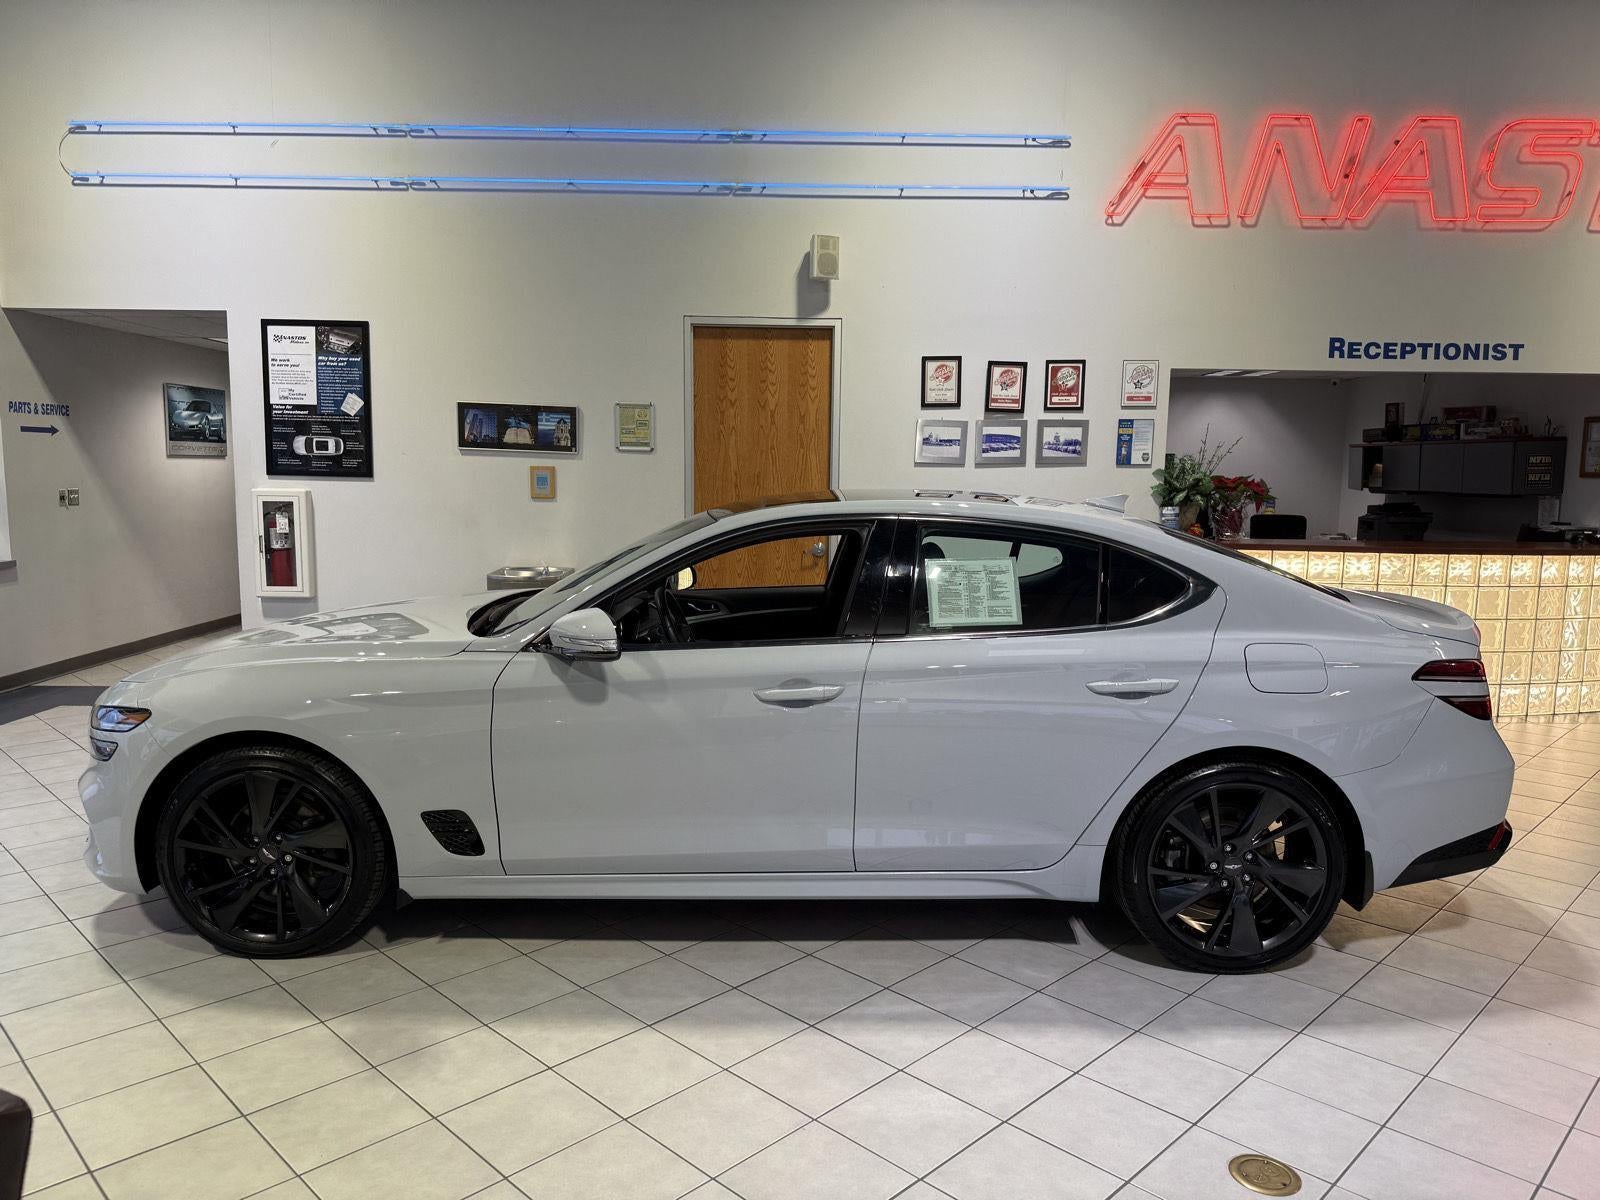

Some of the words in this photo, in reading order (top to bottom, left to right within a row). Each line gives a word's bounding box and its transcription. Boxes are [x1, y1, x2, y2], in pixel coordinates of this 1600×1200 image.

[1105, 112, 1600, 231] ANAS
[8, 400, 32, 415] PARTS
[33, 402, 39, 415] &
[40, 402, 70, 417] SERVICE
